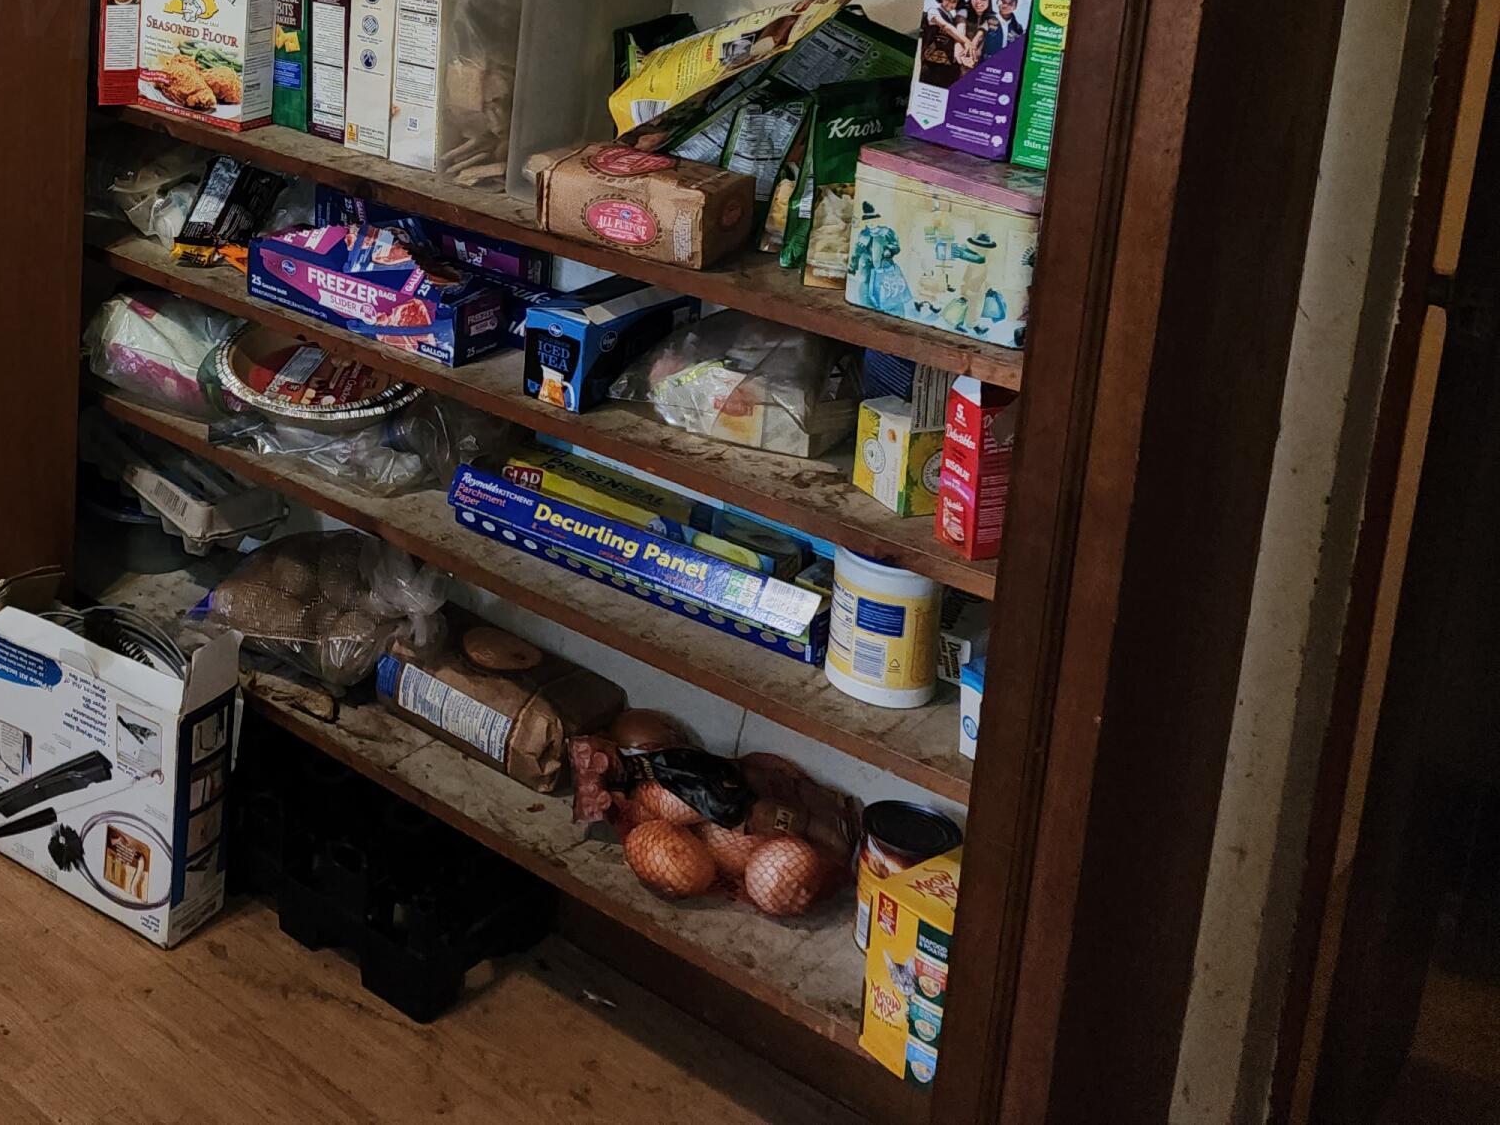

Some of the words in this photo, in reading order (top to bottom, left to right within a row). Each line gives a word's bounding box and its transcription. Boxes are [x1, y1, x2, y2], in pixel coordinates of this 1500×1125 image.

[146, 15, 200, 38] SEASONED
[202, 25, 239, 49] FLOUR
[826, 116, 884, 140] Knorr
[596, 215, 616, 230] ALL
[252, 274, 262, 286] 25
[306, 268, 379, 304] FREEZER
[379, 290, 397, 303] BAGS
[329, 297, 360, 311] SLIDER
[420, 344, 449, 361] GALLON
[539, 339, 571, 359] ICED
[540, 353, 570, 374] TEA
[504, 466, 541, 485] GLAD
[456, 482, 507, 508] Parchment
[461, 471, 501, 496] Reynolds
[500, 488, 535, 507] KITCHENS
[454, 491, 481, 509] Paper
[534, 503, 641, 562] Decurling
[643, 537, 710, 583] Panel
